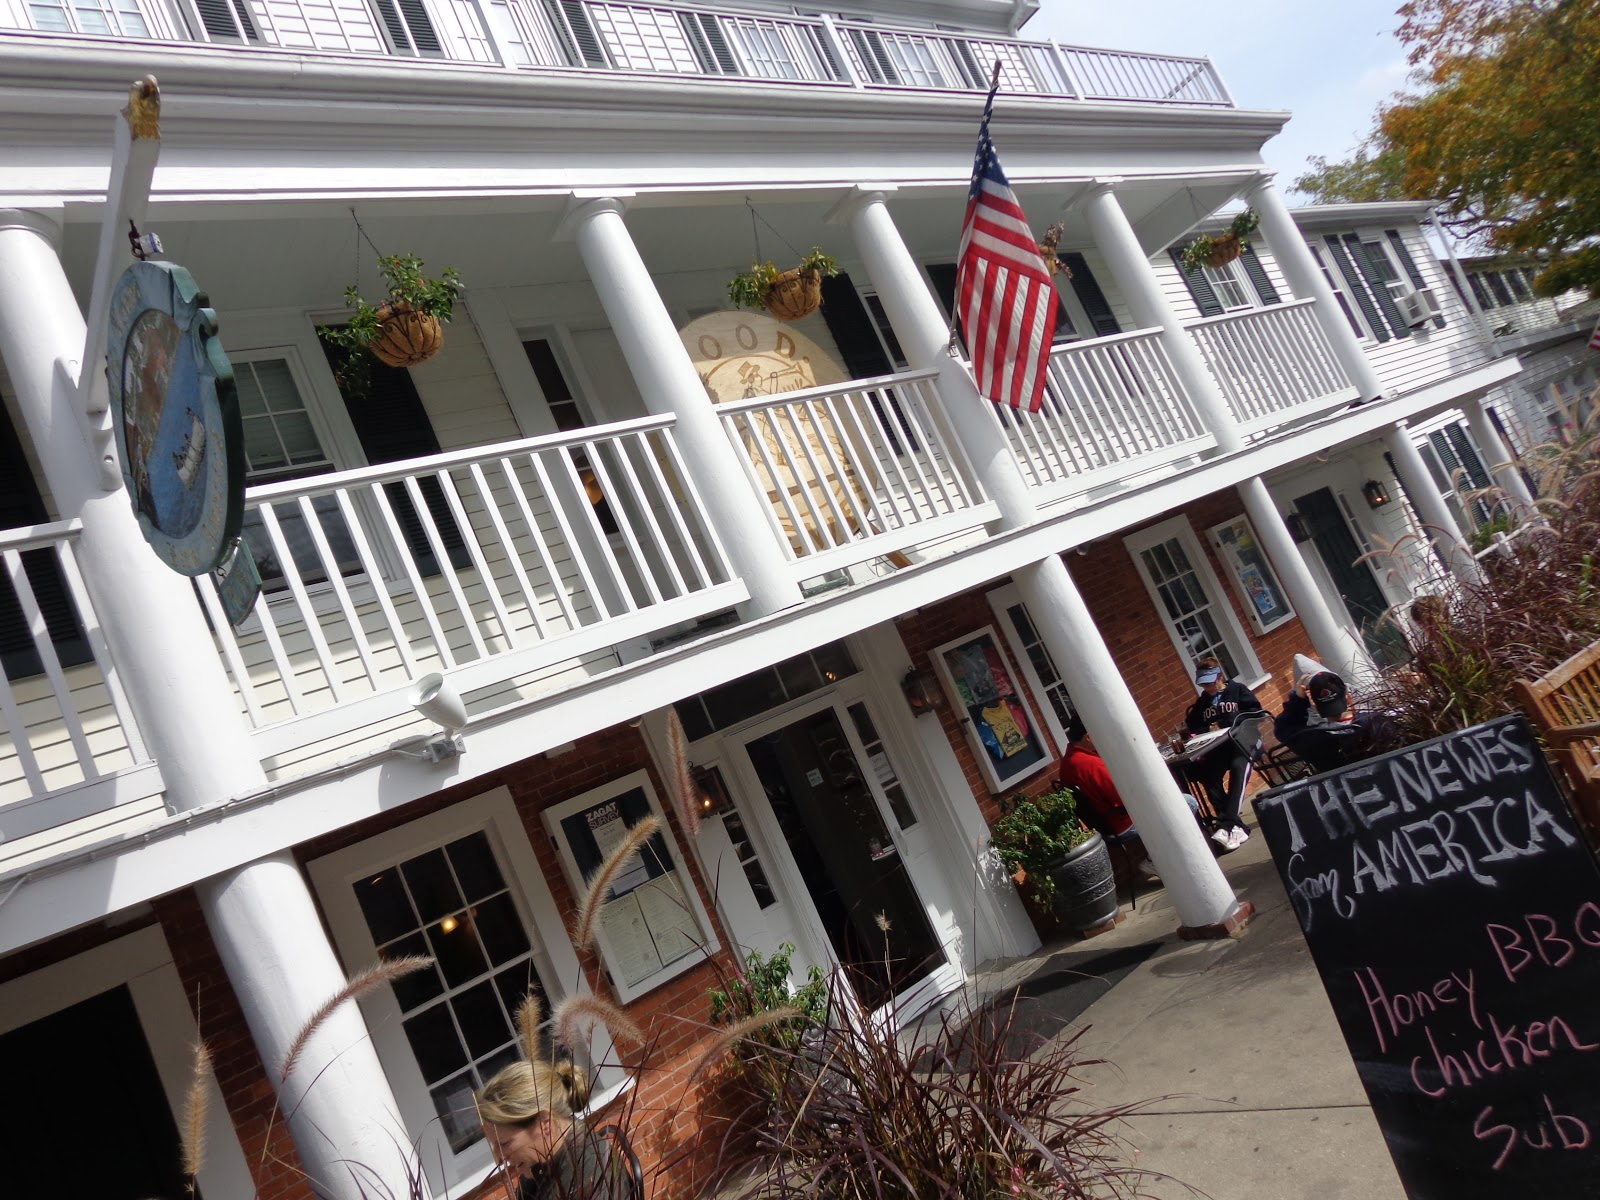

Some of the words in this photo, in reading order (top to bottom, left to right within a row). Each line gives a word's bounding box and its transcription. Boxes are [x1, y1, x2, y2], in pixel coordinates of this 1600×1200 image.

[585, 801, 617, 822] ZAGAT
[589, 808, 620, 830] SURVEY
[1257, 763, 1399, 853] THE
[1390, 723, 1534, 812] NEWES
[1353, 788, 1577, 894] AMERICA
[1353, 966, 1484, 1053] Honey
[1486, 901, 1600, 983] BBQ
[1473, 1094, 1591, 1170] Sub
